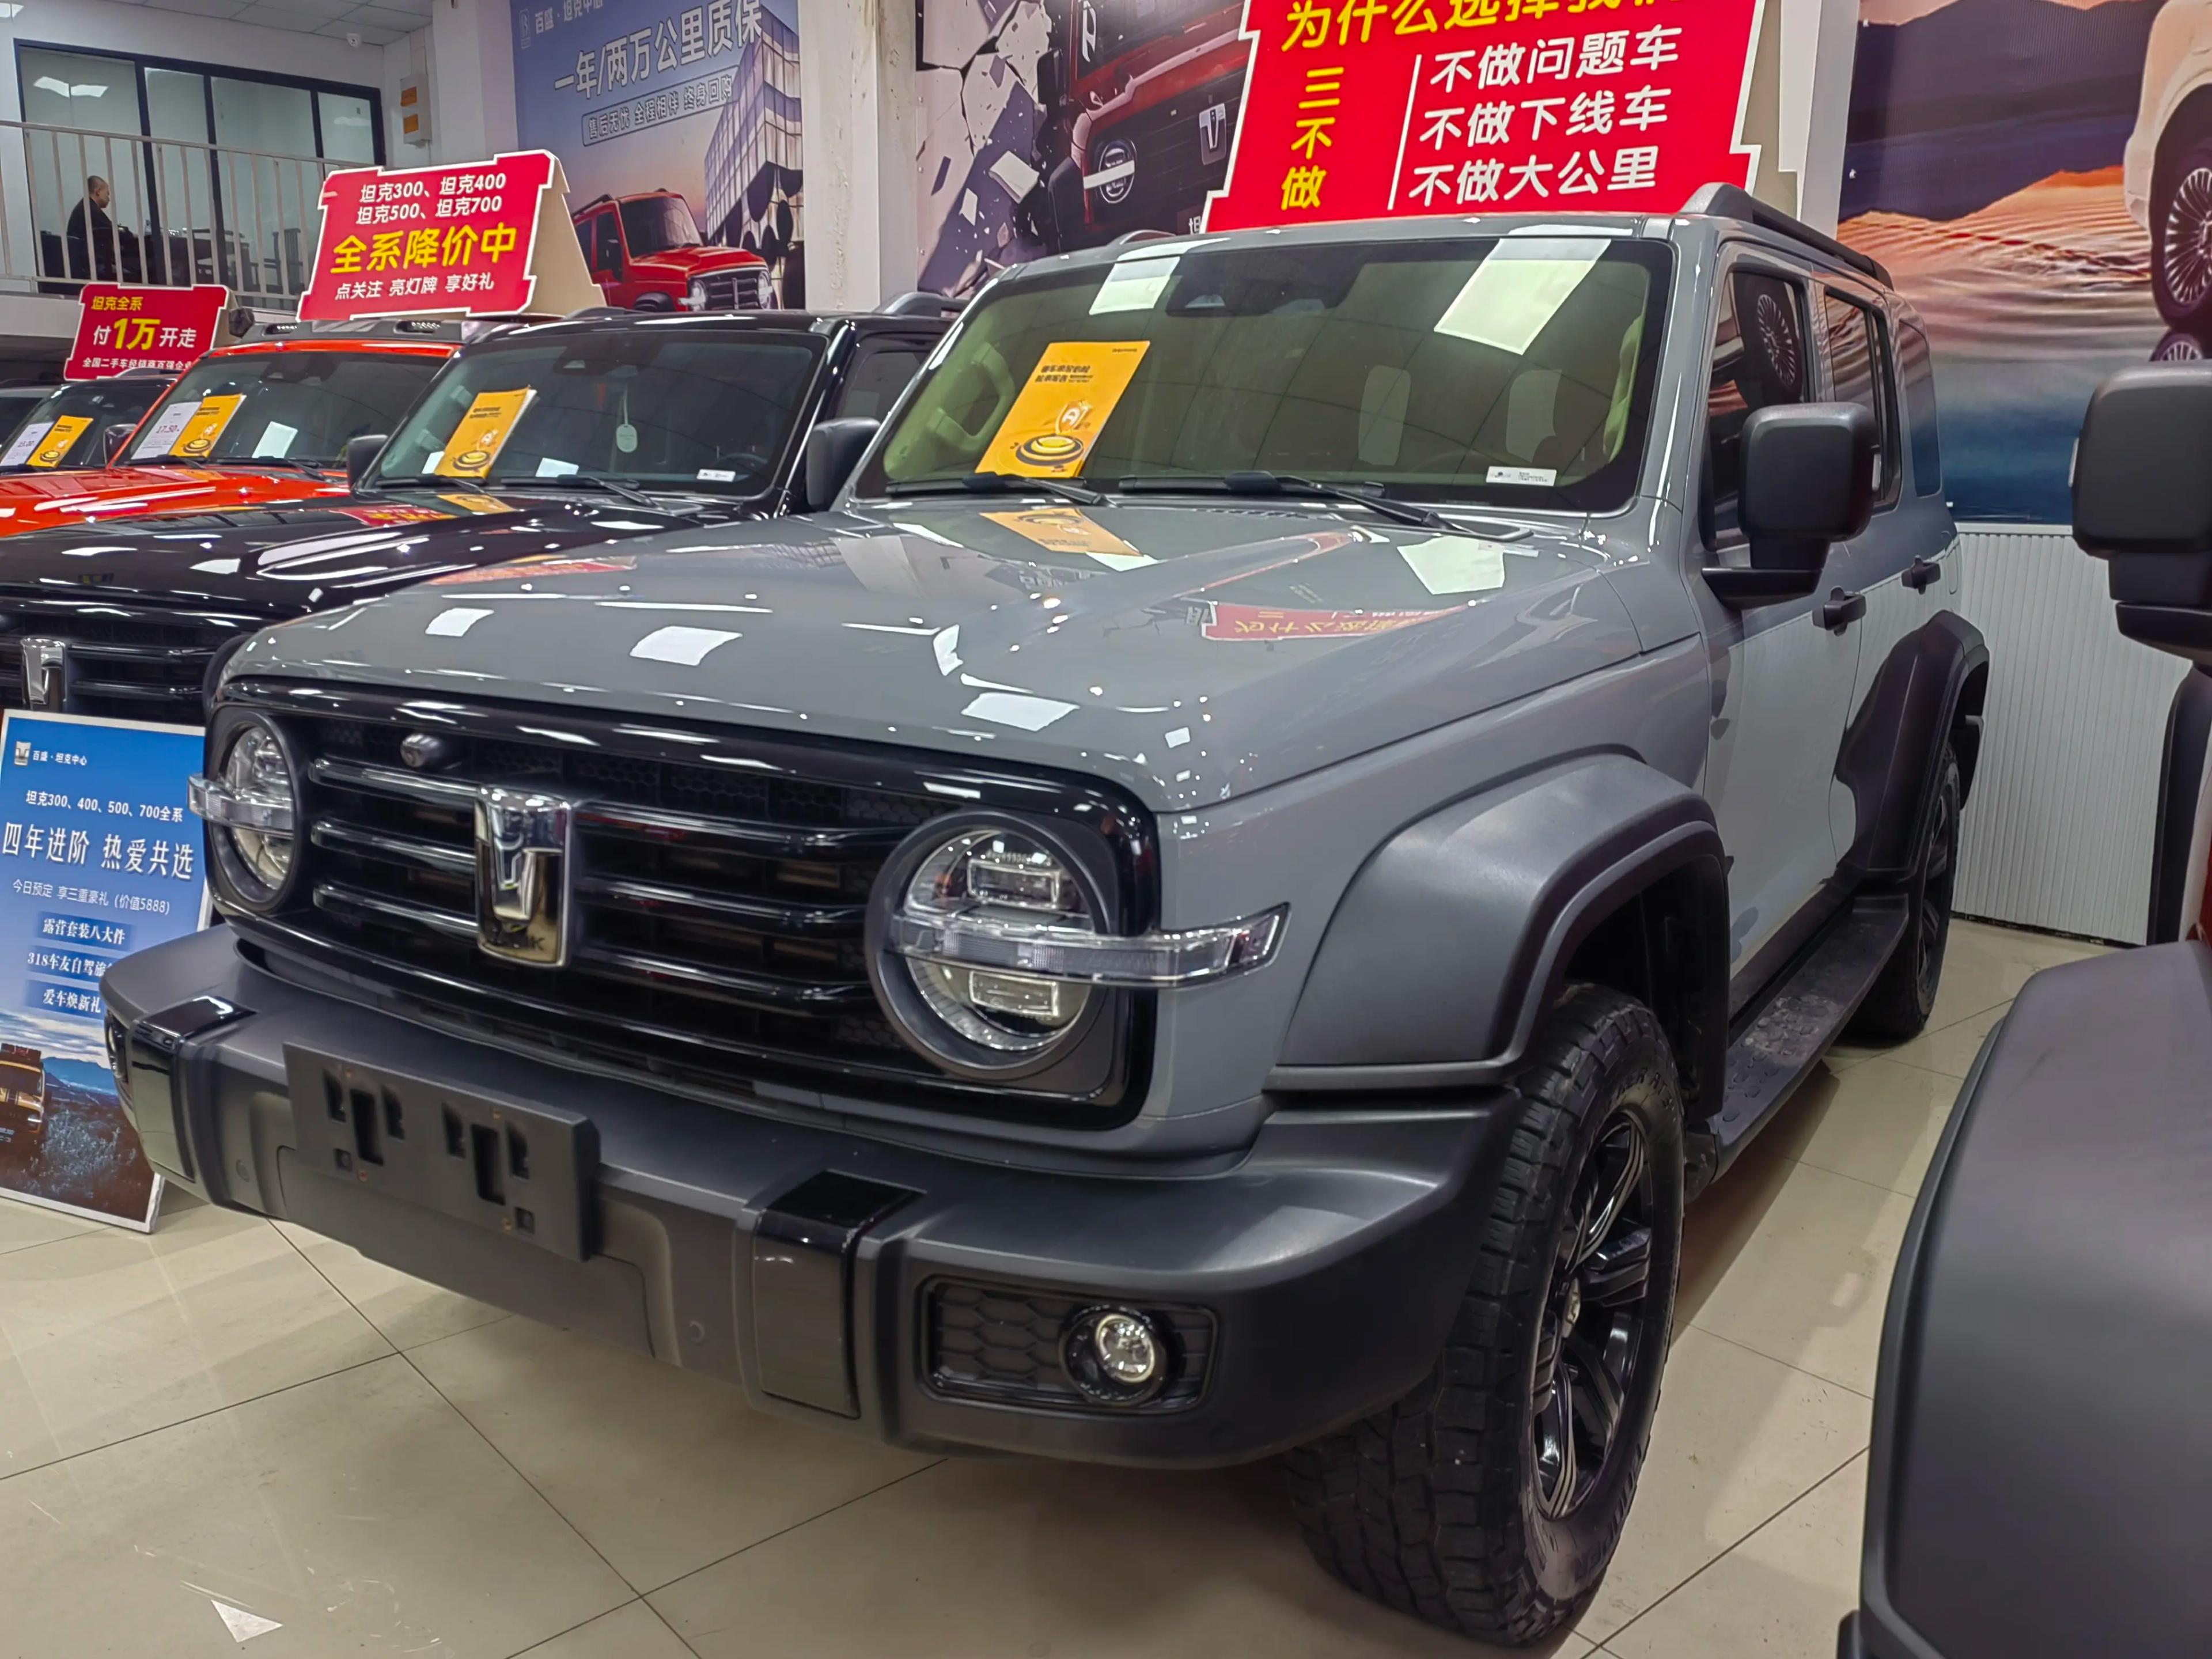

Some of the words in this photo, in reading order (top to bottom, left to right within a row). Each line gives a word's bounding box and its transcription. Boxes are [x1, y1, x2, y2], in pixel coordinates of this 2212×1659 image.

[554, 0, 763, 99] 一年/两万公里质保
[1430, 24, 1683, 93] 不做问题车
[1419, 85, 1672, 151] 不做下线车
[1280, 66, 1344, 211] 三不做
[359, 172, 506, 203] 坦克300、坦克400
[1408, 145, 1659, 210] 不做大公里
[355, 195, 502, 225] 坦克500、坦克700
[330, 222, 517, 274] 全系降价中
[335, 282, 382, 301] 点关注
[388, 276, 438, 298] 亮灯牌
[444, 272, 495, 292] 享好礼
[91, 296, 143, 311] 坦克全系
[33, 751, 88, 766] 百盛·坦克中心
[25, 790, 184, 823] 坦克300、400、500、700全系
[2, 821, 90, 865] 四年进阶
[101, 834, 194, 880] 热爱共选
[13, 879, 53, 898] 今日预定
[43, 918, 126, 945] 露营套装八大件
[27, 952, 112, 978] 318车友自驾旅
[43, 989, 101, 1014] 爱车焕新礼
